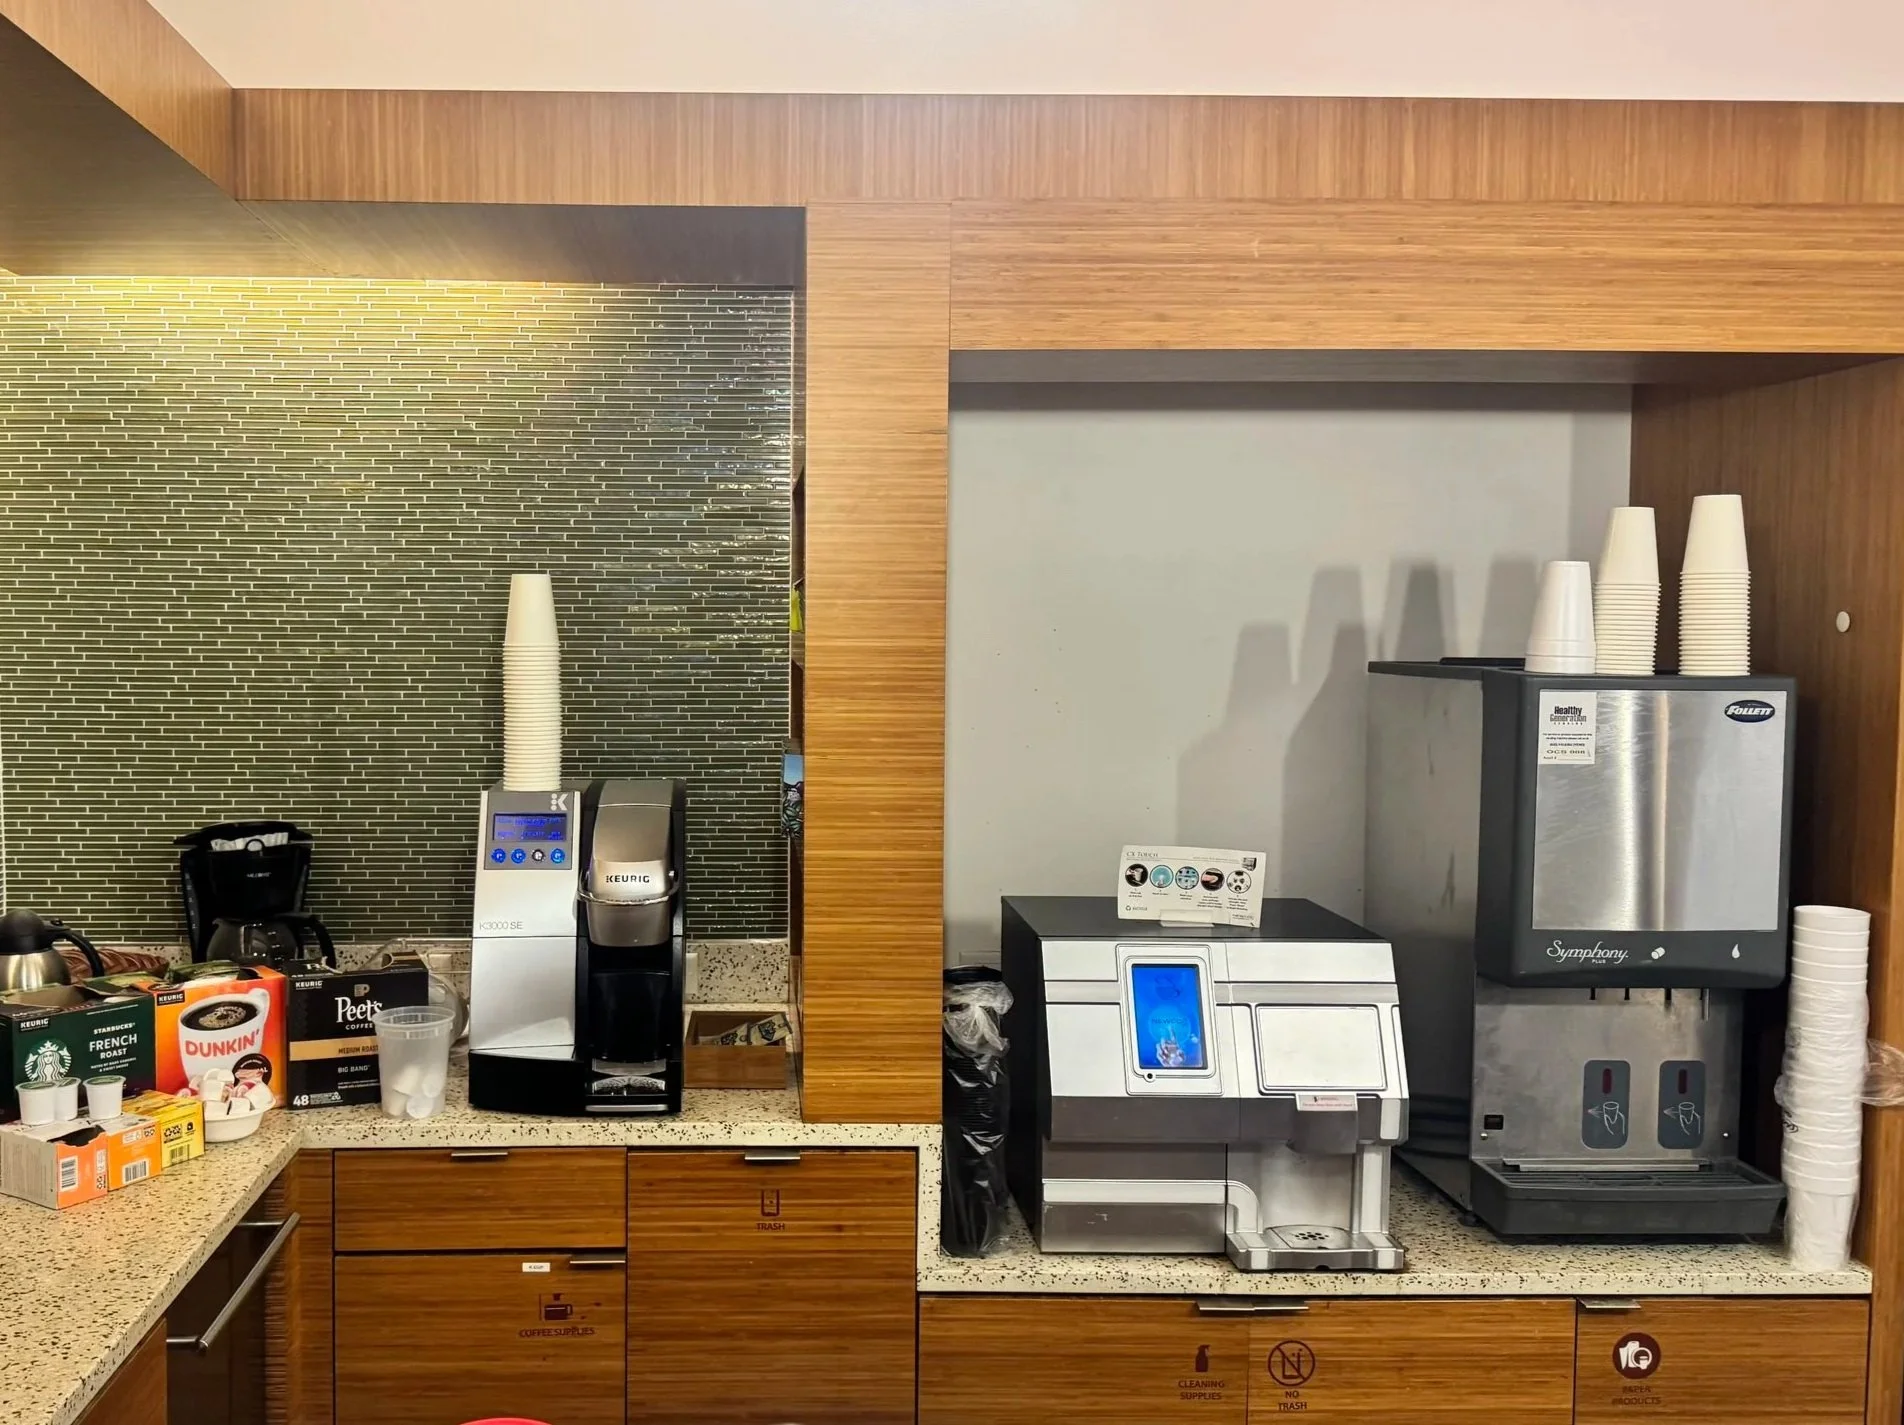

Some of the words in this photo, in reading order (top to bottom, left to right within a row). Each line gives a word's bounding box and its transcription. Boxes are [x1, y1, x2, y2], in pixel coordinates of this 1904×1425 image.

[1554, 705, 1583, 716] Healthy
[1726, 705, 1774, 716] FOLLETT
[1549, 713, 1587, 722] Generation
[605, 874, 650, 883] KEURIG
[479, 921, 509, 930] K3000
[510, 921, 523, 930] SE
[295, 980, 323, 988] KEURIG
[158, 993, 184, 1002] KEURIG
[335, 996, 383, 1024] Peet's
[20, 1017, 49, 1029] KEURIG
[345, 1022, 374, 1031] COFFEE
[93, 1023, 133, 1035] STARBUCKS
[89, 1033, 138, 1053] FRENCH
[185, 1029, 260, 1058] DUNKIN'
[100, 1047, 128, 1060] ROAST
[338, 1045, 361, 1055] MEDIUM
[338, 1065, 349, 1074] BIG
[350, 1065, 369, 1073] BANG
[293, 1094, 310, 1107] 48
[755, 1222, 786, 1231] TRASH
[519, 1327, 553, 1338] COFFEE
[554, 1326, 595, 1337] SUPPLIES
[1178, 1379, 1225, 1389] CLEANING
[1180, 1391, 1222, 1401] SUPPLIES
[1284, 1390, 1300, 1399] NO
[1278, 1401, 1308, 1412] TRASH
